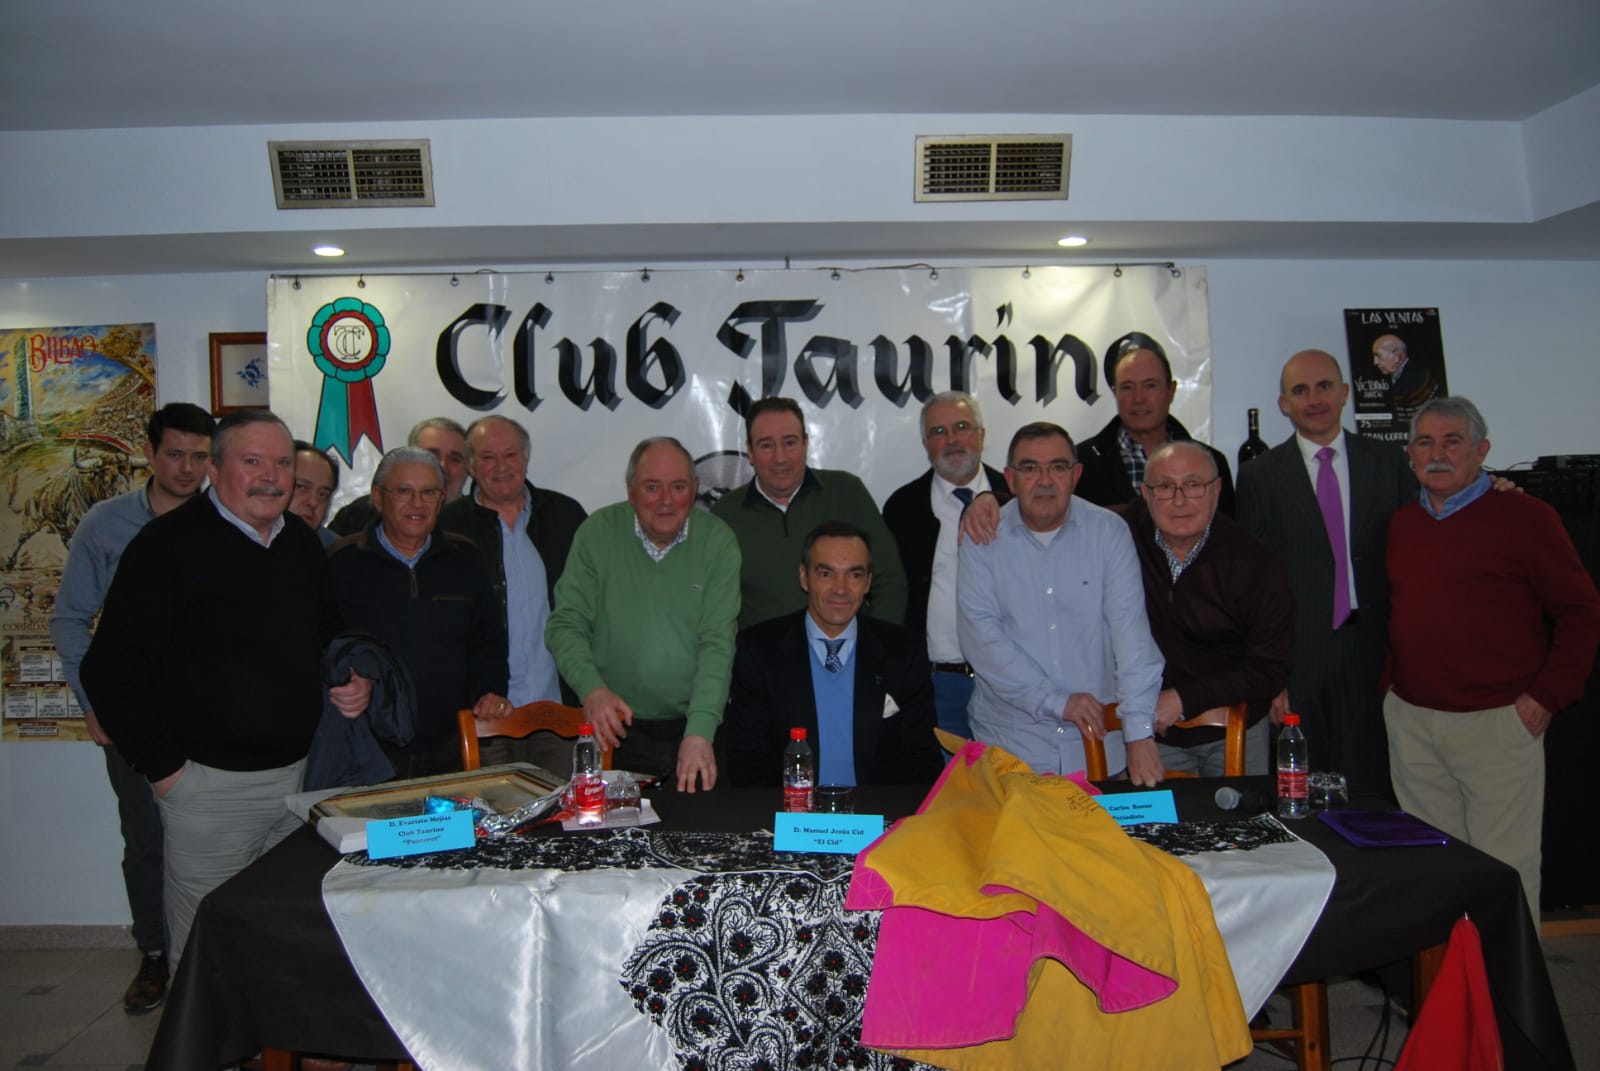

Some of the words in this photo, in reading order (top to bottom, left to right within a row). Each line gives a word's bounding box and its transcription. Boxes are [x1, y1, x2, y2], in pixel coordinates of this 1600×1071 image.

[1361, 311, 1382, 324] LAS
[1384, 311, 1424, 324] VENTAS
[436, 301, 687, 412] Club
[389, 820, 397, 828] D.
[398, 829, 415, 837] Club
[417, 827, 444, 835] Taurino
